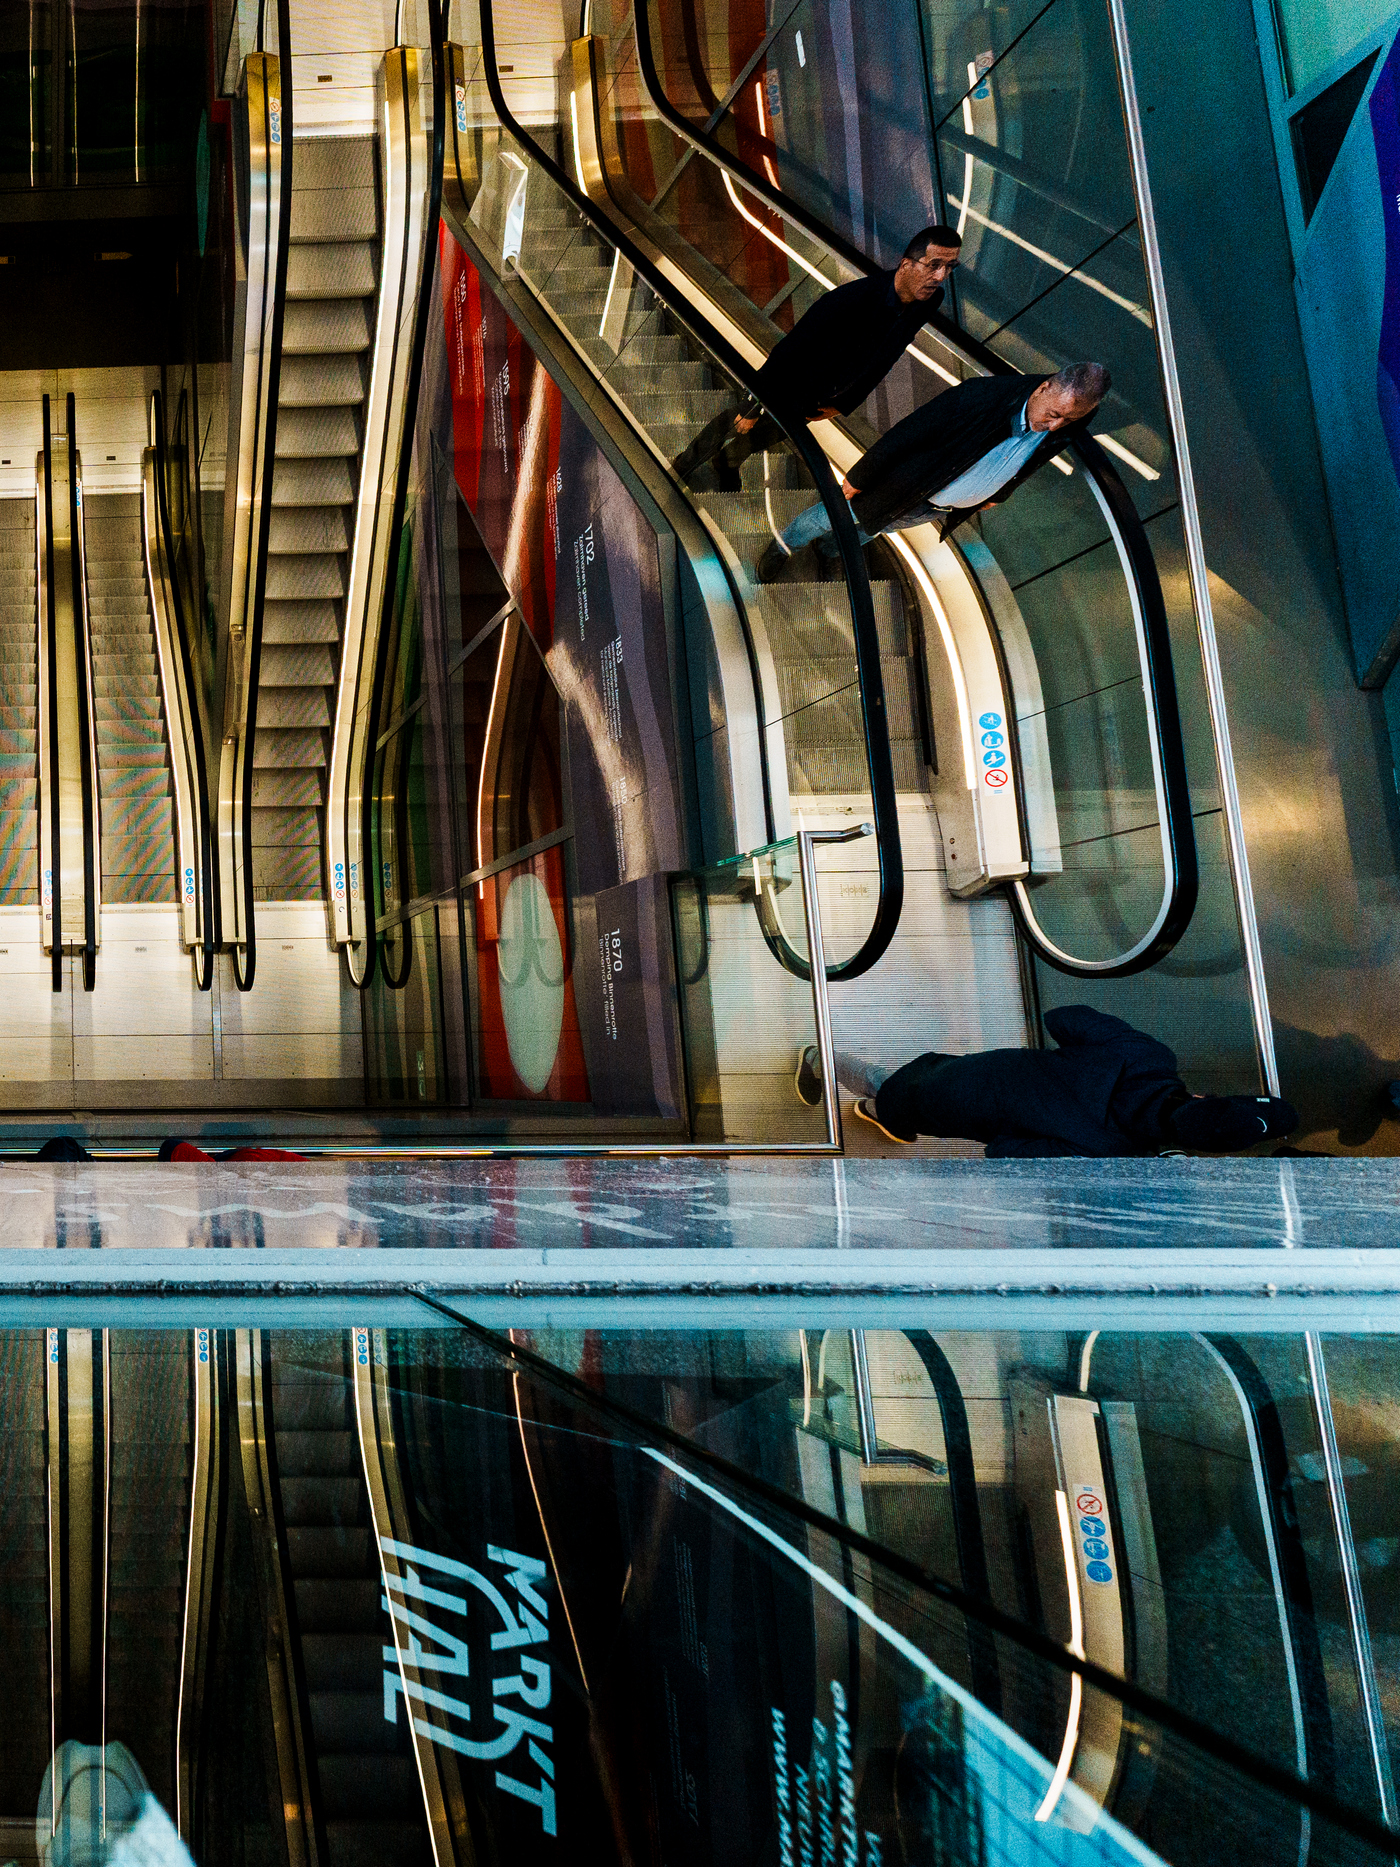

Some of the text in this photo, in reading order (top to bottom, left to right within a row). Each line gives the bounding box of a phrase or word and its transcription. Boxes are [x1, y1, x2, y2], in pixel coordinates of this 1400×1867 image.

[582, 522, 597, 566] 1702
[604, 933, 617, 1039] Demping Binnenrotte
[610, 928, 623, 972] 1870
[380, 1536, 490, 1738] HAL
[486, 1543, 557, 1837] MARKT
